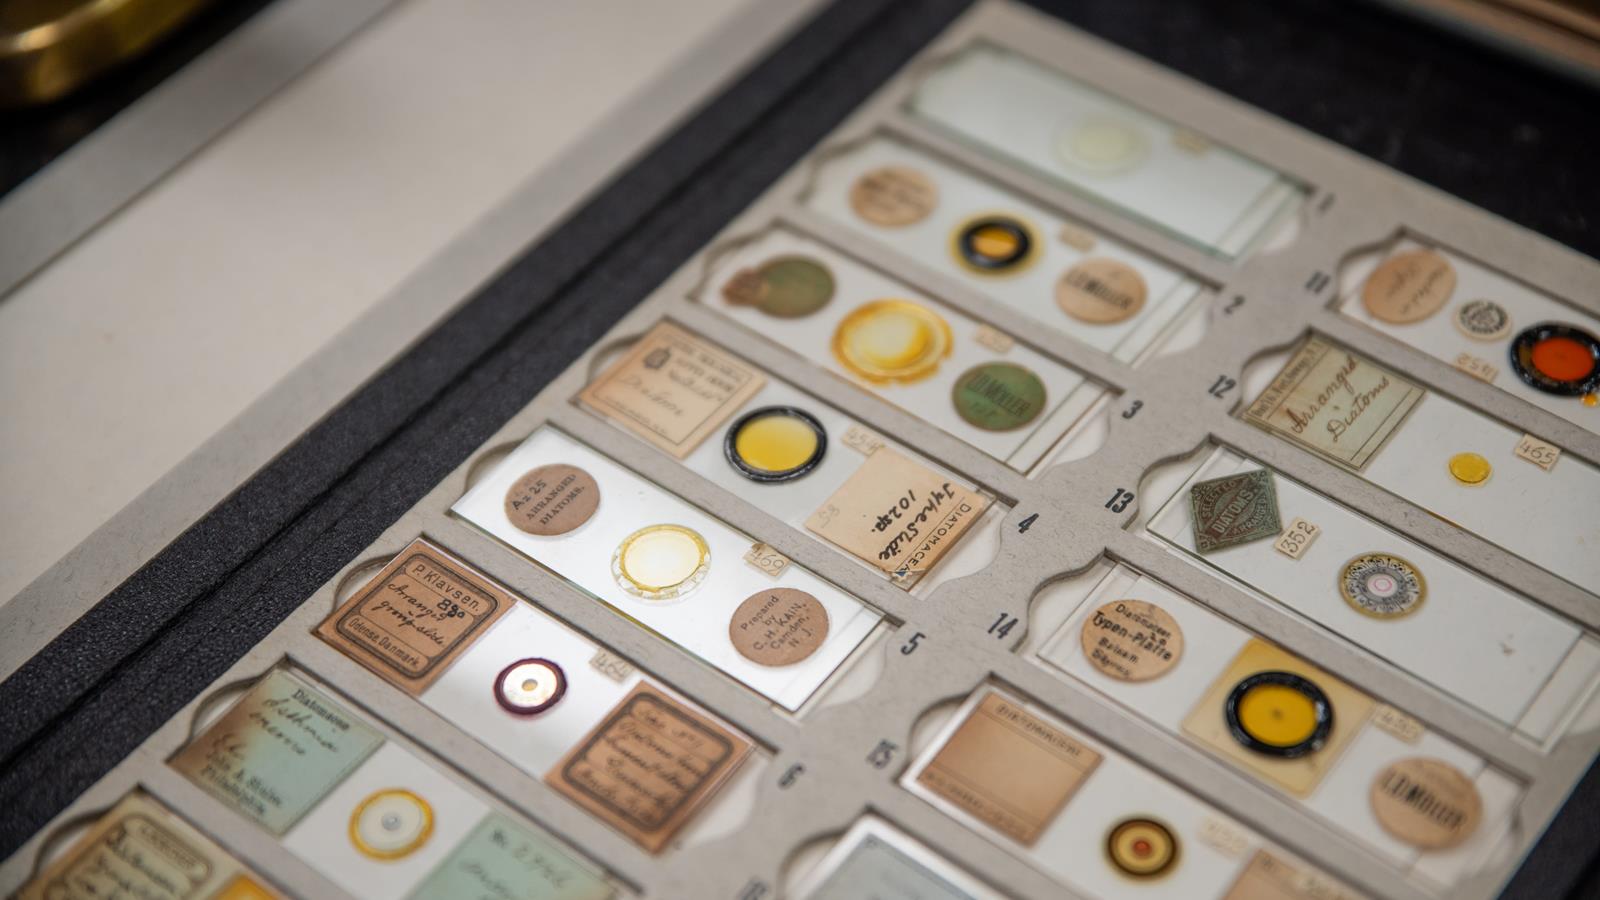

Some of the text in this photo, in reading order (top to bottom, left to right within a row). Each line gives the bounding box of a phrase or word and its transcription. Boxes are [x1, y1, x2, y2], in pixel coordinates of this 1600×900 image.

[1224, 295, 1245, 315] 2
[1208, 374, 1237, 399] 12
[1121, 399, 1144, 419] 3
[1326, 376, 1390, 442] Diatoms
[1519, 440, 1556, 465] 465
[1104, 488, 1135, 513] 13
[1018, 513, 1039, 533] 4
[1280, 521, 1315, 554] 352
[412, 563, 426, 577] P.
[740, 594, 780, 632] Prepared
[763, 613, 777, 627] by
[987, 612, 1019, 639] 14
[900, 632, 927, 656] 5
[1092, 610, 1173, 662] Typen-Platte
[866, 739, 898, 770] 15
[777, 762, 806, 790] 6
